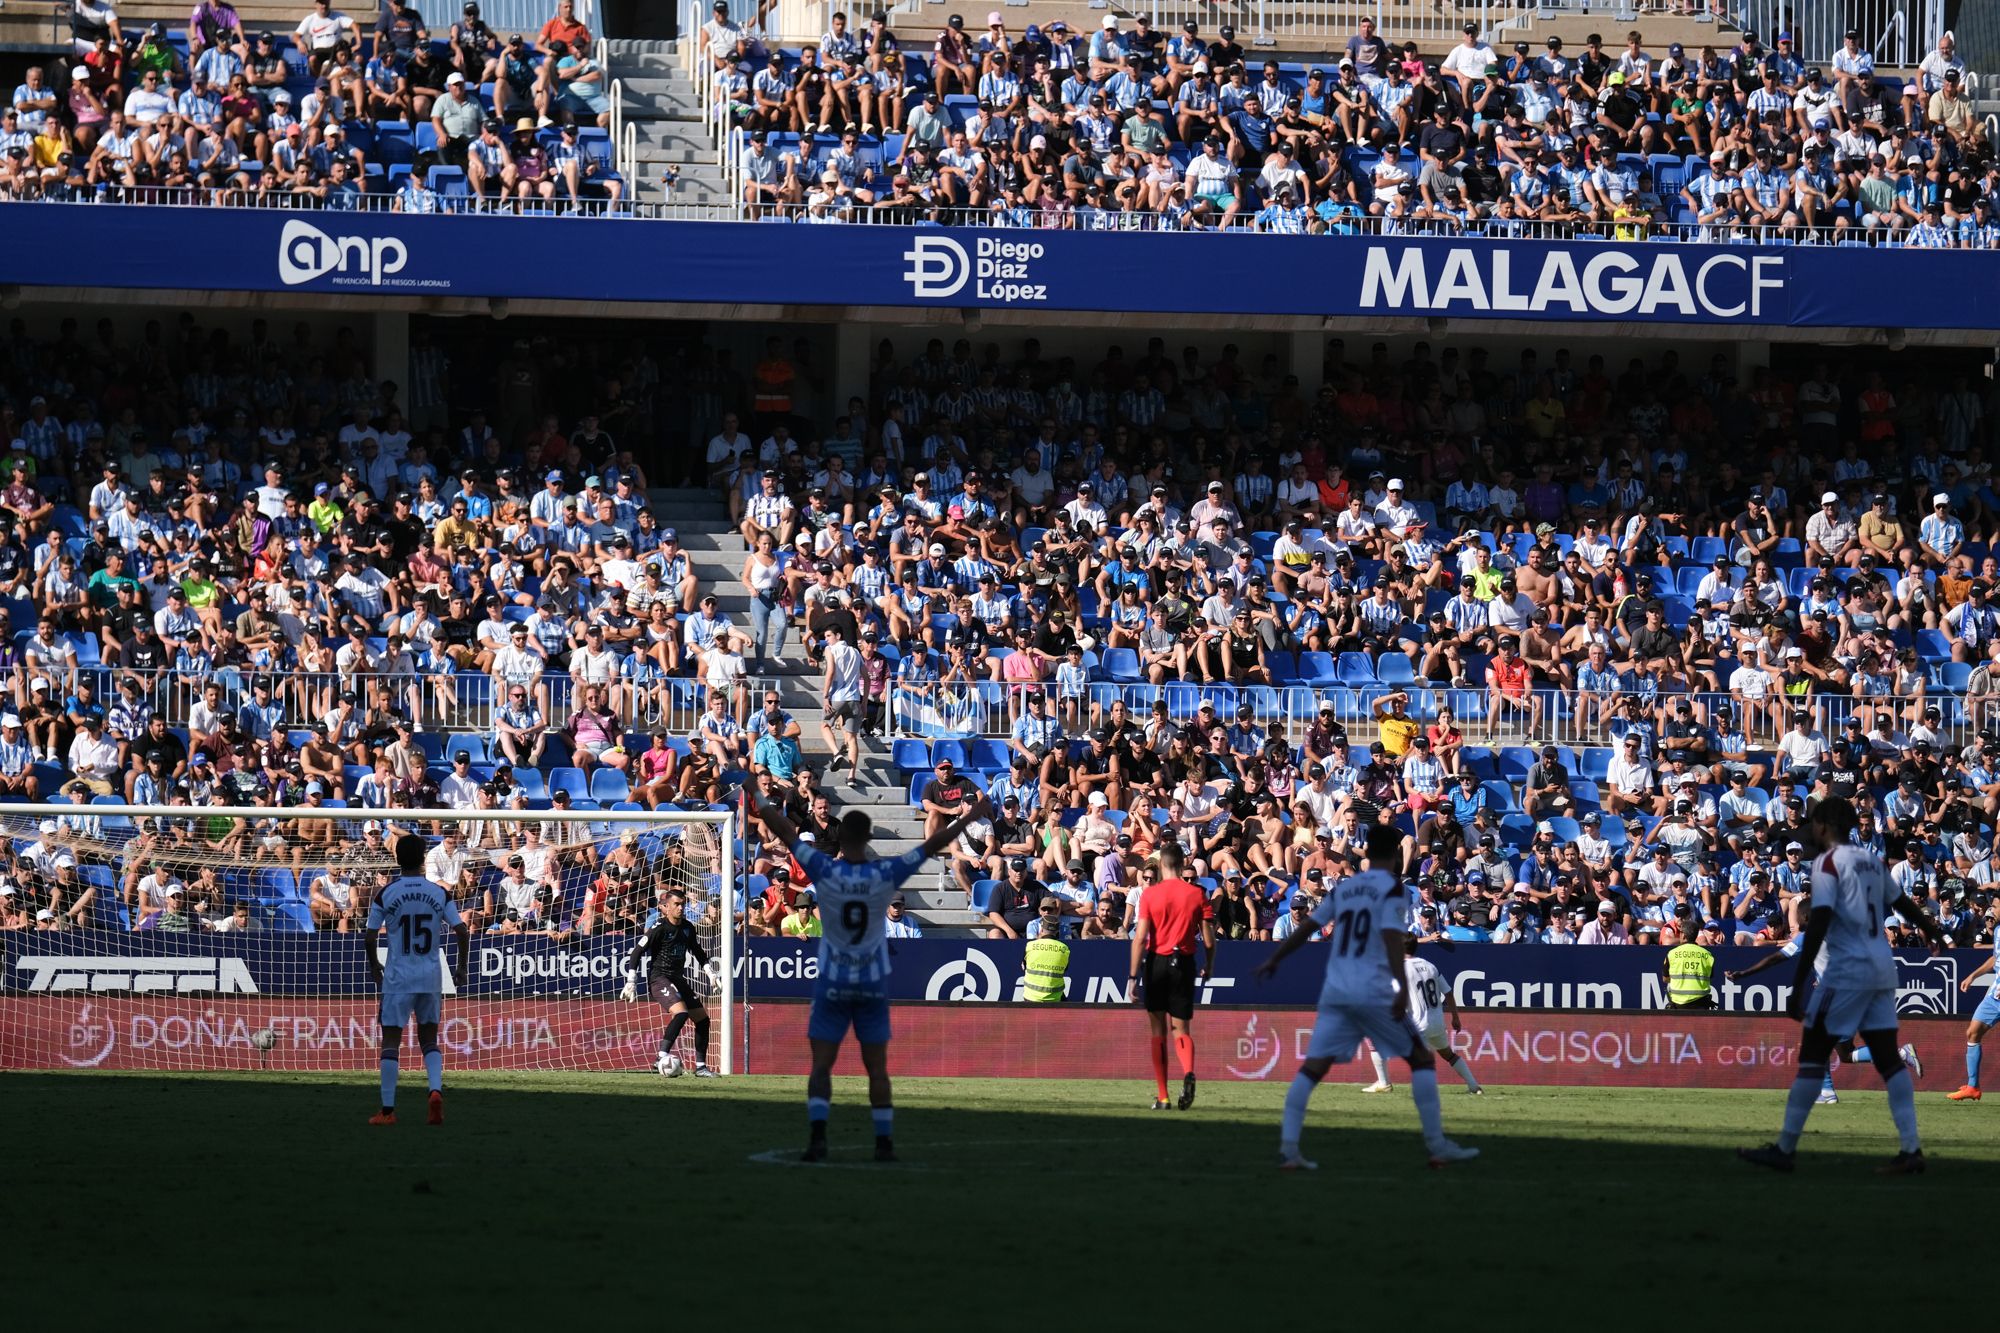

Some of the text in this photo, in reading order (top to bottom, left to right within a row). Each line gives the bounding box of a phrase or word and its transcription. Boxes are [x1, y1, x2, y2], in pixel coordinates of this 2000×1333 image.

[977, 237, 1044, 263] Diego
[977, 258, 1028, 279] Díaz
[382, 278, 391, 286] DE
[391, 278, 416, 287] RIESGOS
[417, 279, 451, 288] LABORALES
[977, 279, 1047, 302] López
[399, 913, 433, 957] 15
[843, 901, 868, 945] 9
[1338, 908, 1371, 958] 19
[1674, 950, 1709, 960] SEGURIDAD
[1684, 961, 1700, 970] 057
[1416, 978, 1438, 1009] 18
[1452, 970, 1622, 1009] Garum
[1450, 1030, 1702, 1068] RANCISQUITA
